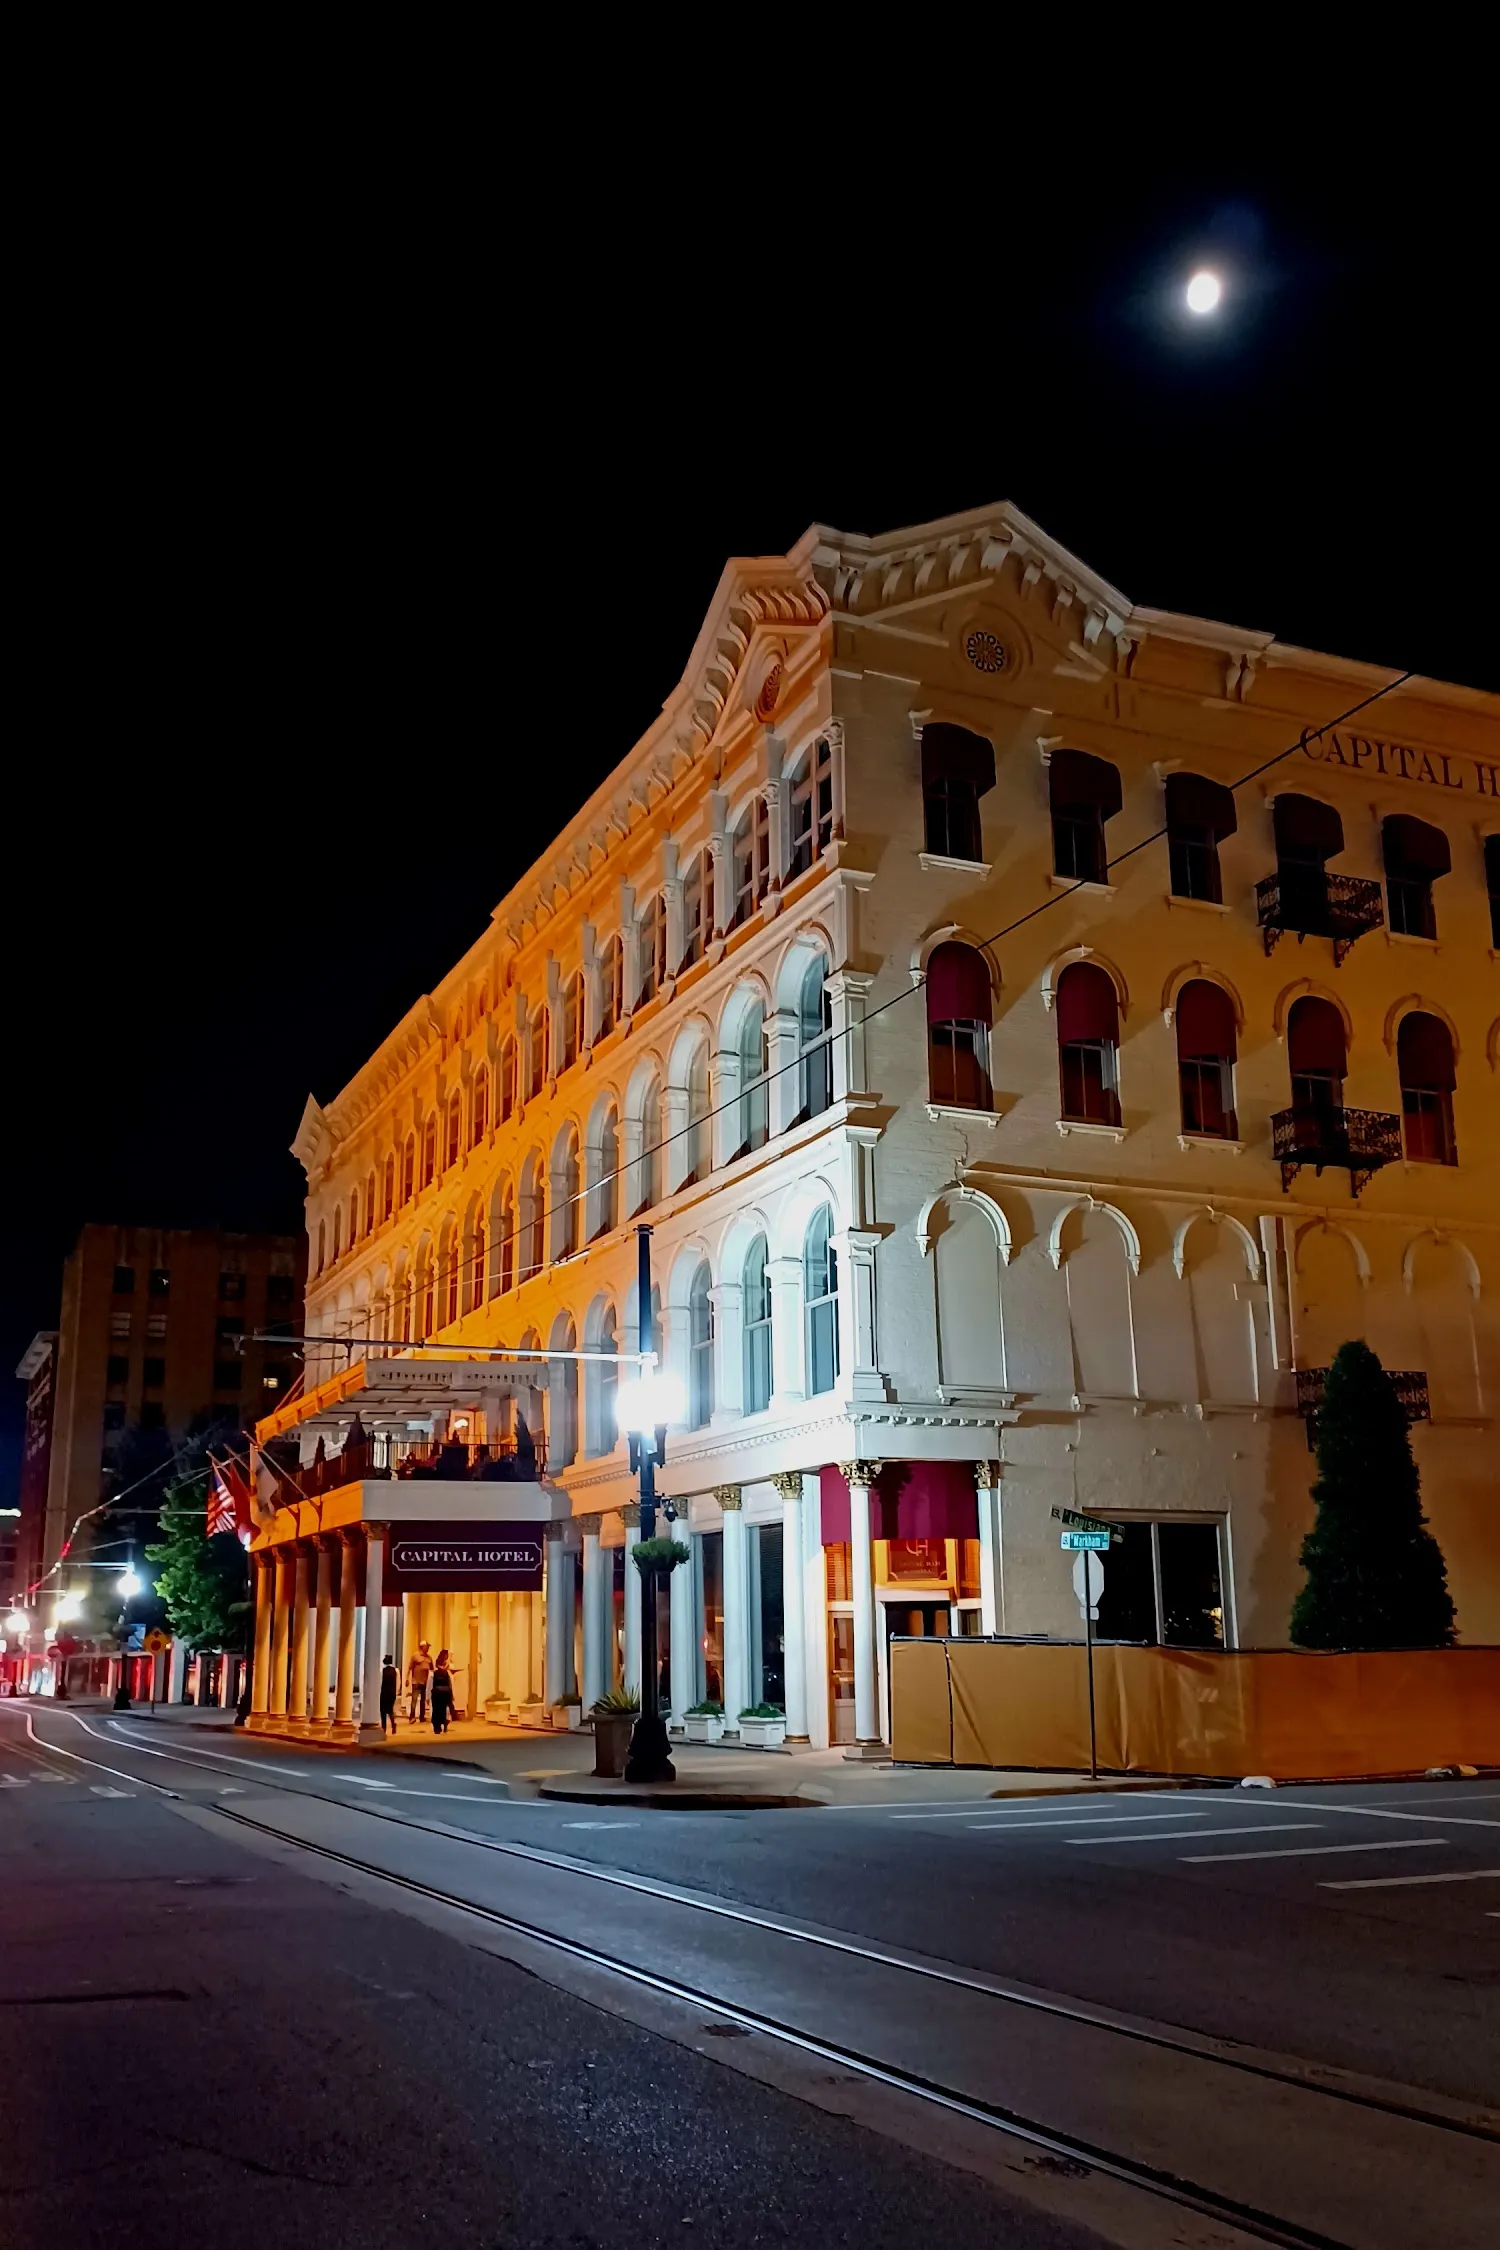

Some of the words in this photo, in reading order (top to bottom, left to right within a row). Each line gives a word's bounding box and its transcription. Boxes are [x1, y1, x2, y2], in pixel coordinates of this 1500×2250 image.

[1300, 727, 1462, 789] CAPITAL
[1073, 1535, 1101, 1547] Markham
[400, 1550, 473, 1562] CAPITAL
[477, 1551, 535, 1562] HOTEL
